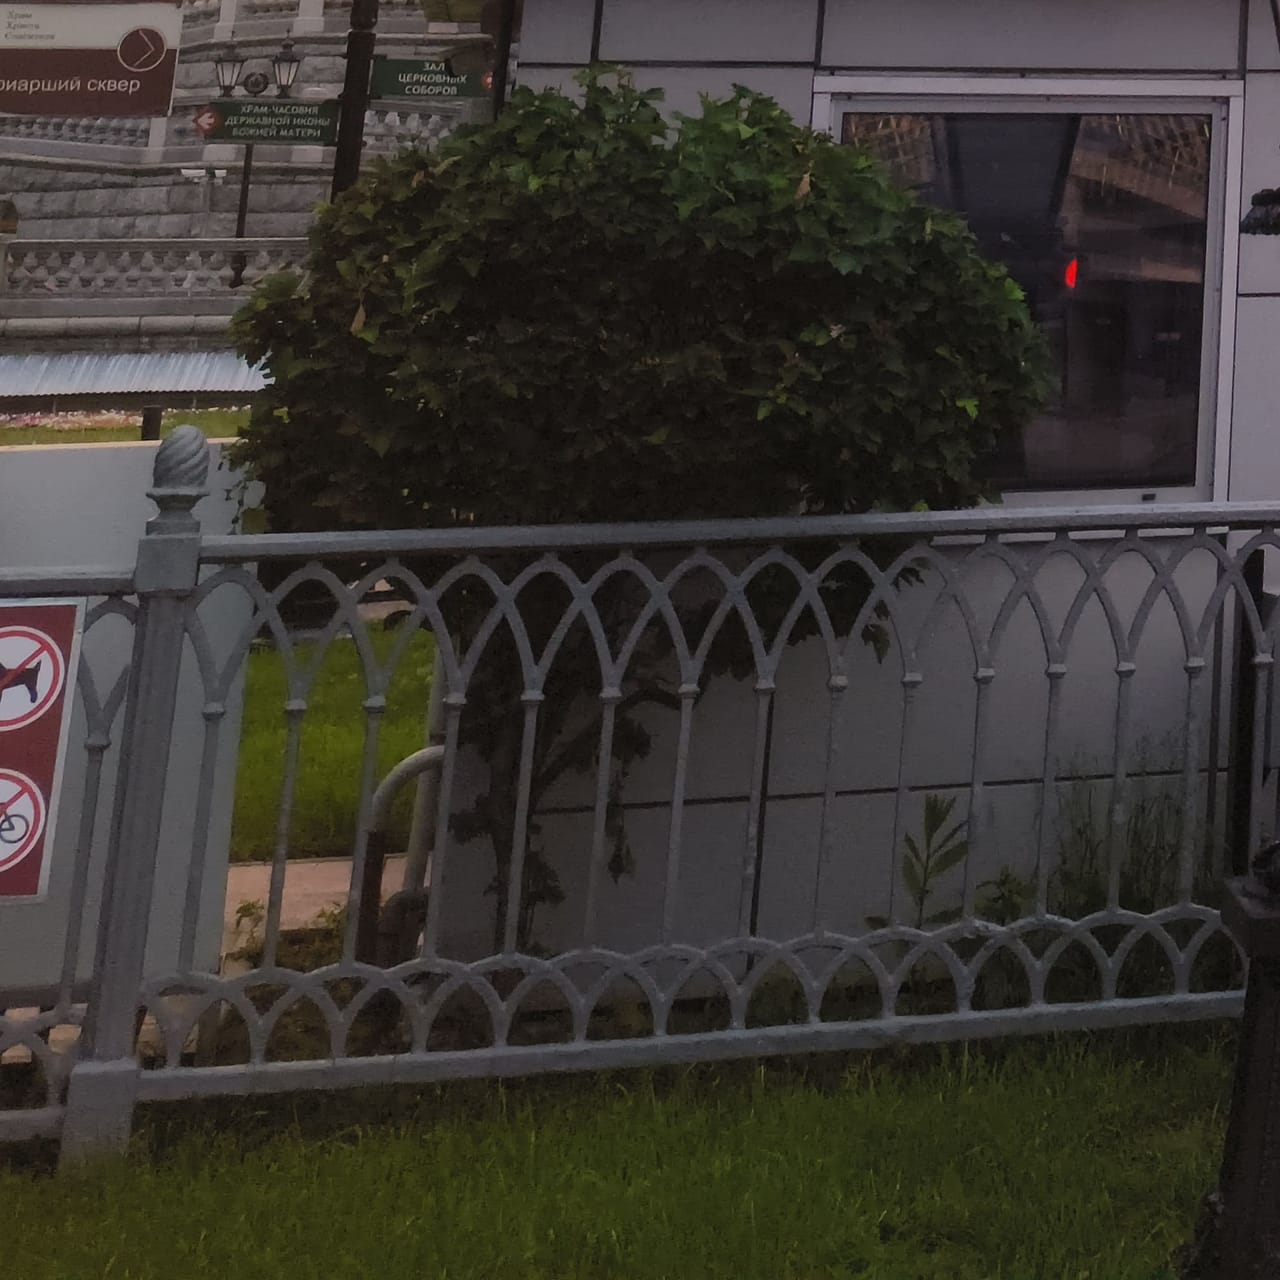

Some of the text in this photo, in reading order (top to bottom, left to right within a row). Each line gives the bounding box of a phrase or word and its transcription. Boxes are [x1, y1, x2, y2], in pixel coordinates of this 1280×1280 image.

[423, 62, 446, 72] ЗАЛ
[87, 79, 141, 94] сквер
[404, 85, 458, 96] СОБОРОВ
[240, 104, 319, 115] ХРАМ-ЧАСОВНЯ
[293, 116, 330, 127] ИКОНЫ
[279, 127, 321, 137] МАТЕРИ
